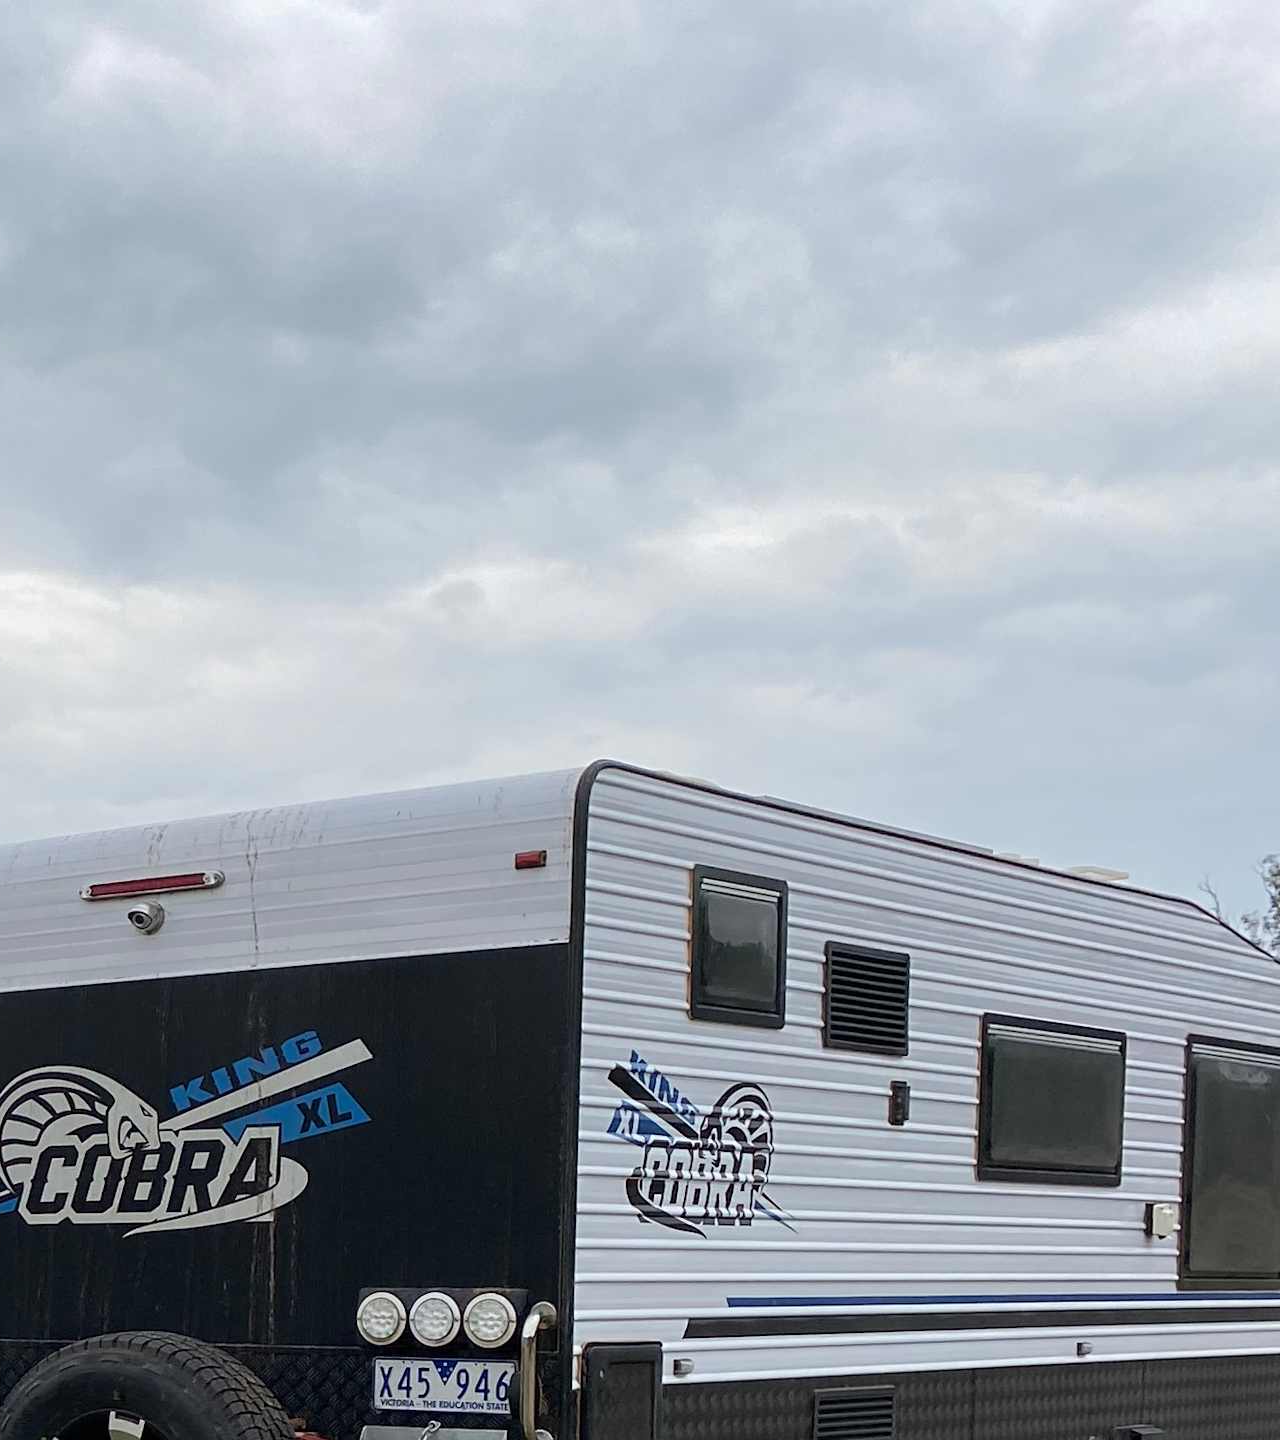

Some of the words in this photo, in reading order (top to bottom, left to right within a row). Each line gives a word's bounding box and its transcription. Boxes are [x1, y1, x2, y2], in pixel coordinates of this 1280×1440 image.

[169, 1030, 322, 1112] KING
[630, 1049, 698, 1126] KING
[297, 1093, 352, 1134] XL
[617, 1107, 647, 1143] XL
[24, 1136, 274, 1214] COBRA
[641, 1140, 755, 1222] COBRA
[380, 1366, 430, 1399] X45
[456, 1368, 509, 1402] 946
[380, 1398, 415, 1407] VICTORIA
[423, 1399, 436, 1409] THE
[438, 1400, 484, 1411] EDUCATION
[486, 1402, 509, 1412] STATE
